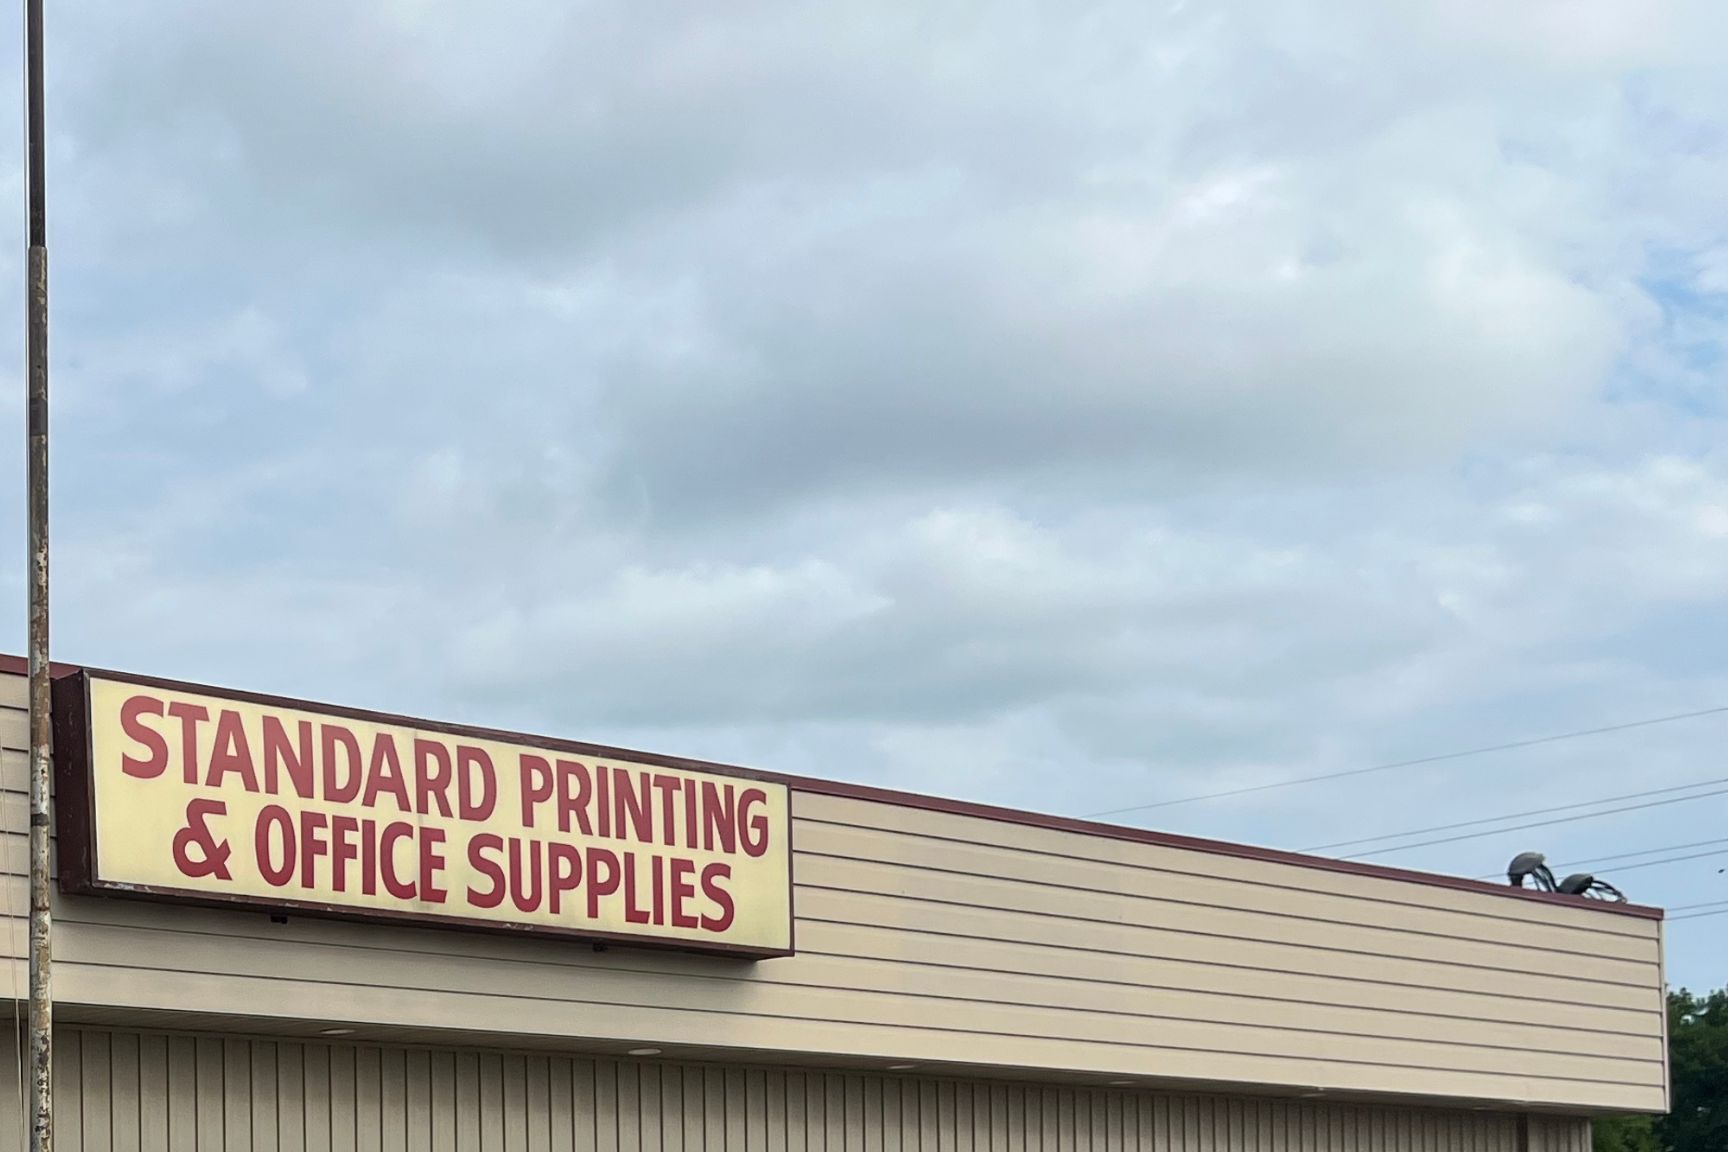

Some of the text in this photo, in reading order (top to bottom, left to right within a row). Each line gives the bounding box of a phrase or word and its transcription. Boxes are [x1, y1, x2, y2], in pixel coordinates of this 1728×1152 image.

[120, 695, 769, 857] STANDARD PRINTING
[173, 798, 735, 932] & OFFICE SUPPLIES
